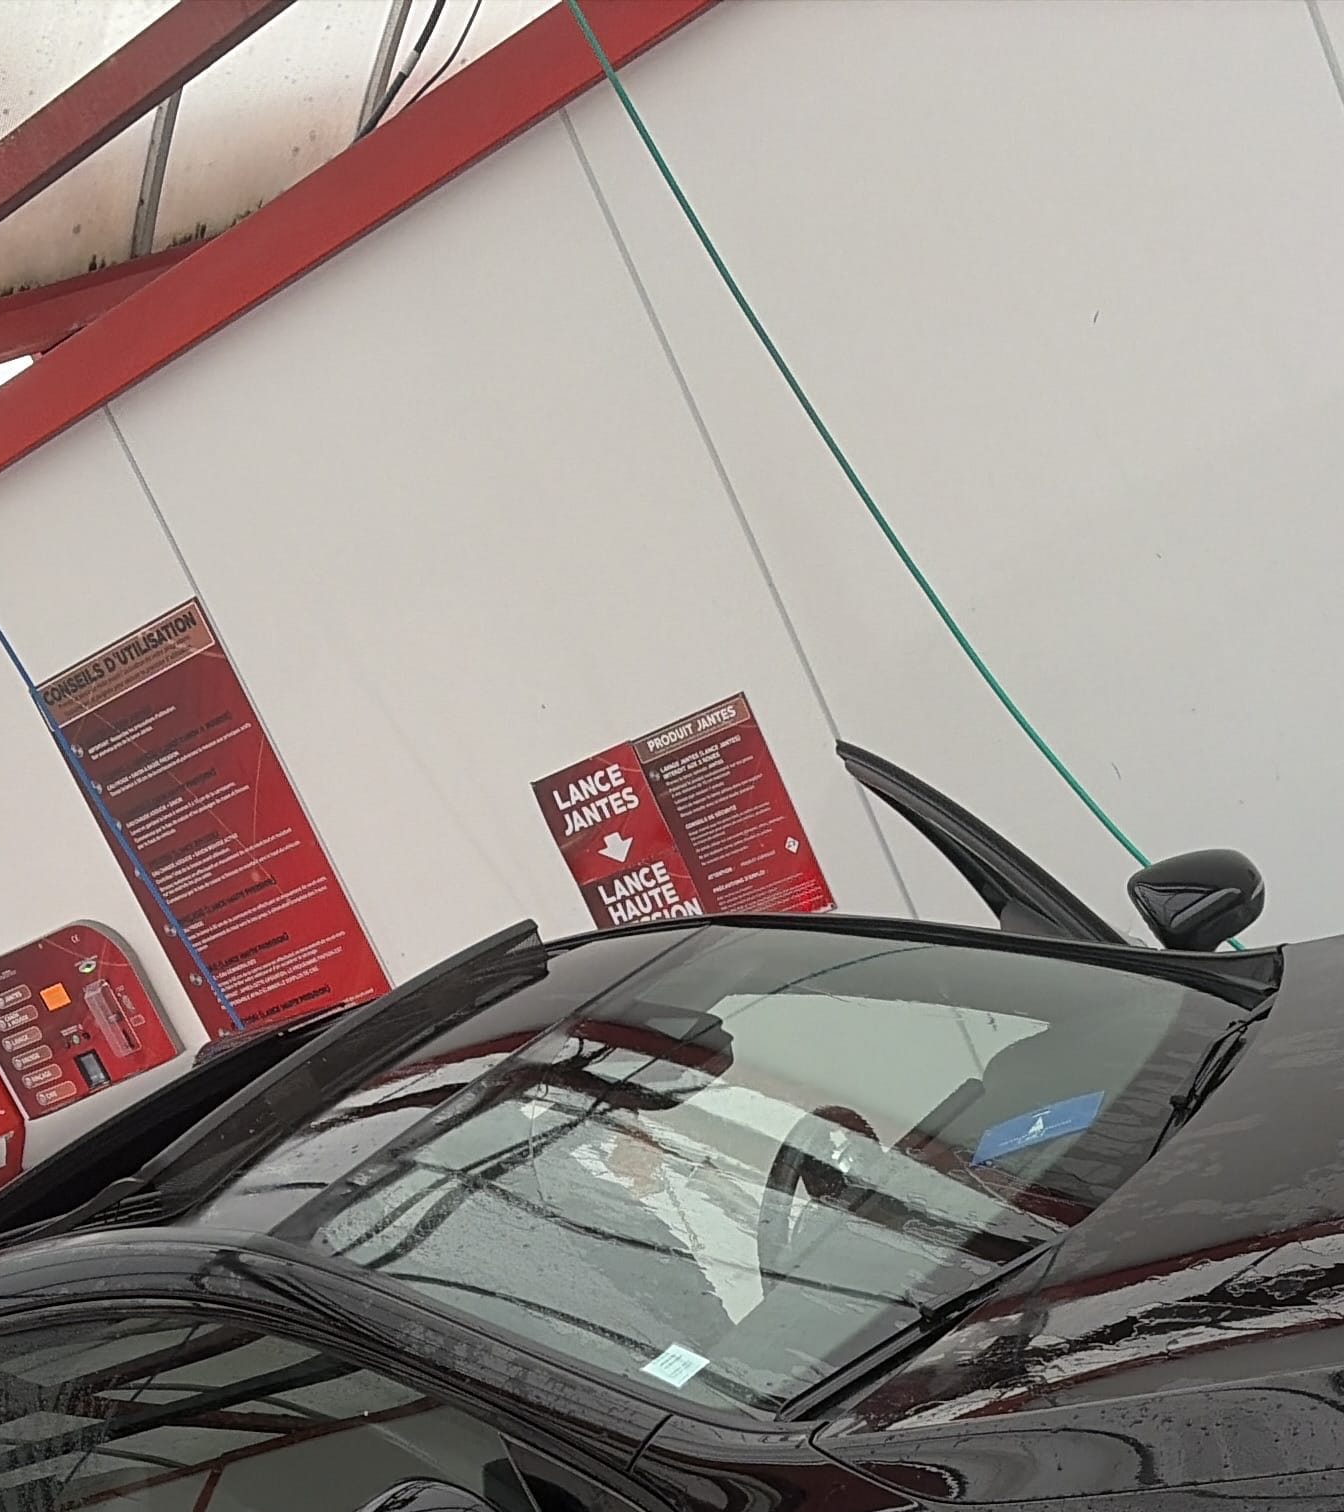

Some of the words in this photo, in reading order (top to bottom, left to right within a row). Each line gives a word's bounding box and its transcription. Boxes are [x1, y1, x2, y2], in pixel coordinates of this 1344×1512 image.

[41, 662, 106, 707] CONSEILS
[102, 610, 197, 673] D'UTILISATION
[646, 723, 695, 753] PRODUIT
[696, 704, 737, 735] JANTES
[552, 764, 626, 811] LANCE
[563, 788, 640, 837] JANTES
[597, 861, 670, 905] LANCE
[608, 882, 679, 925] HAUTE
